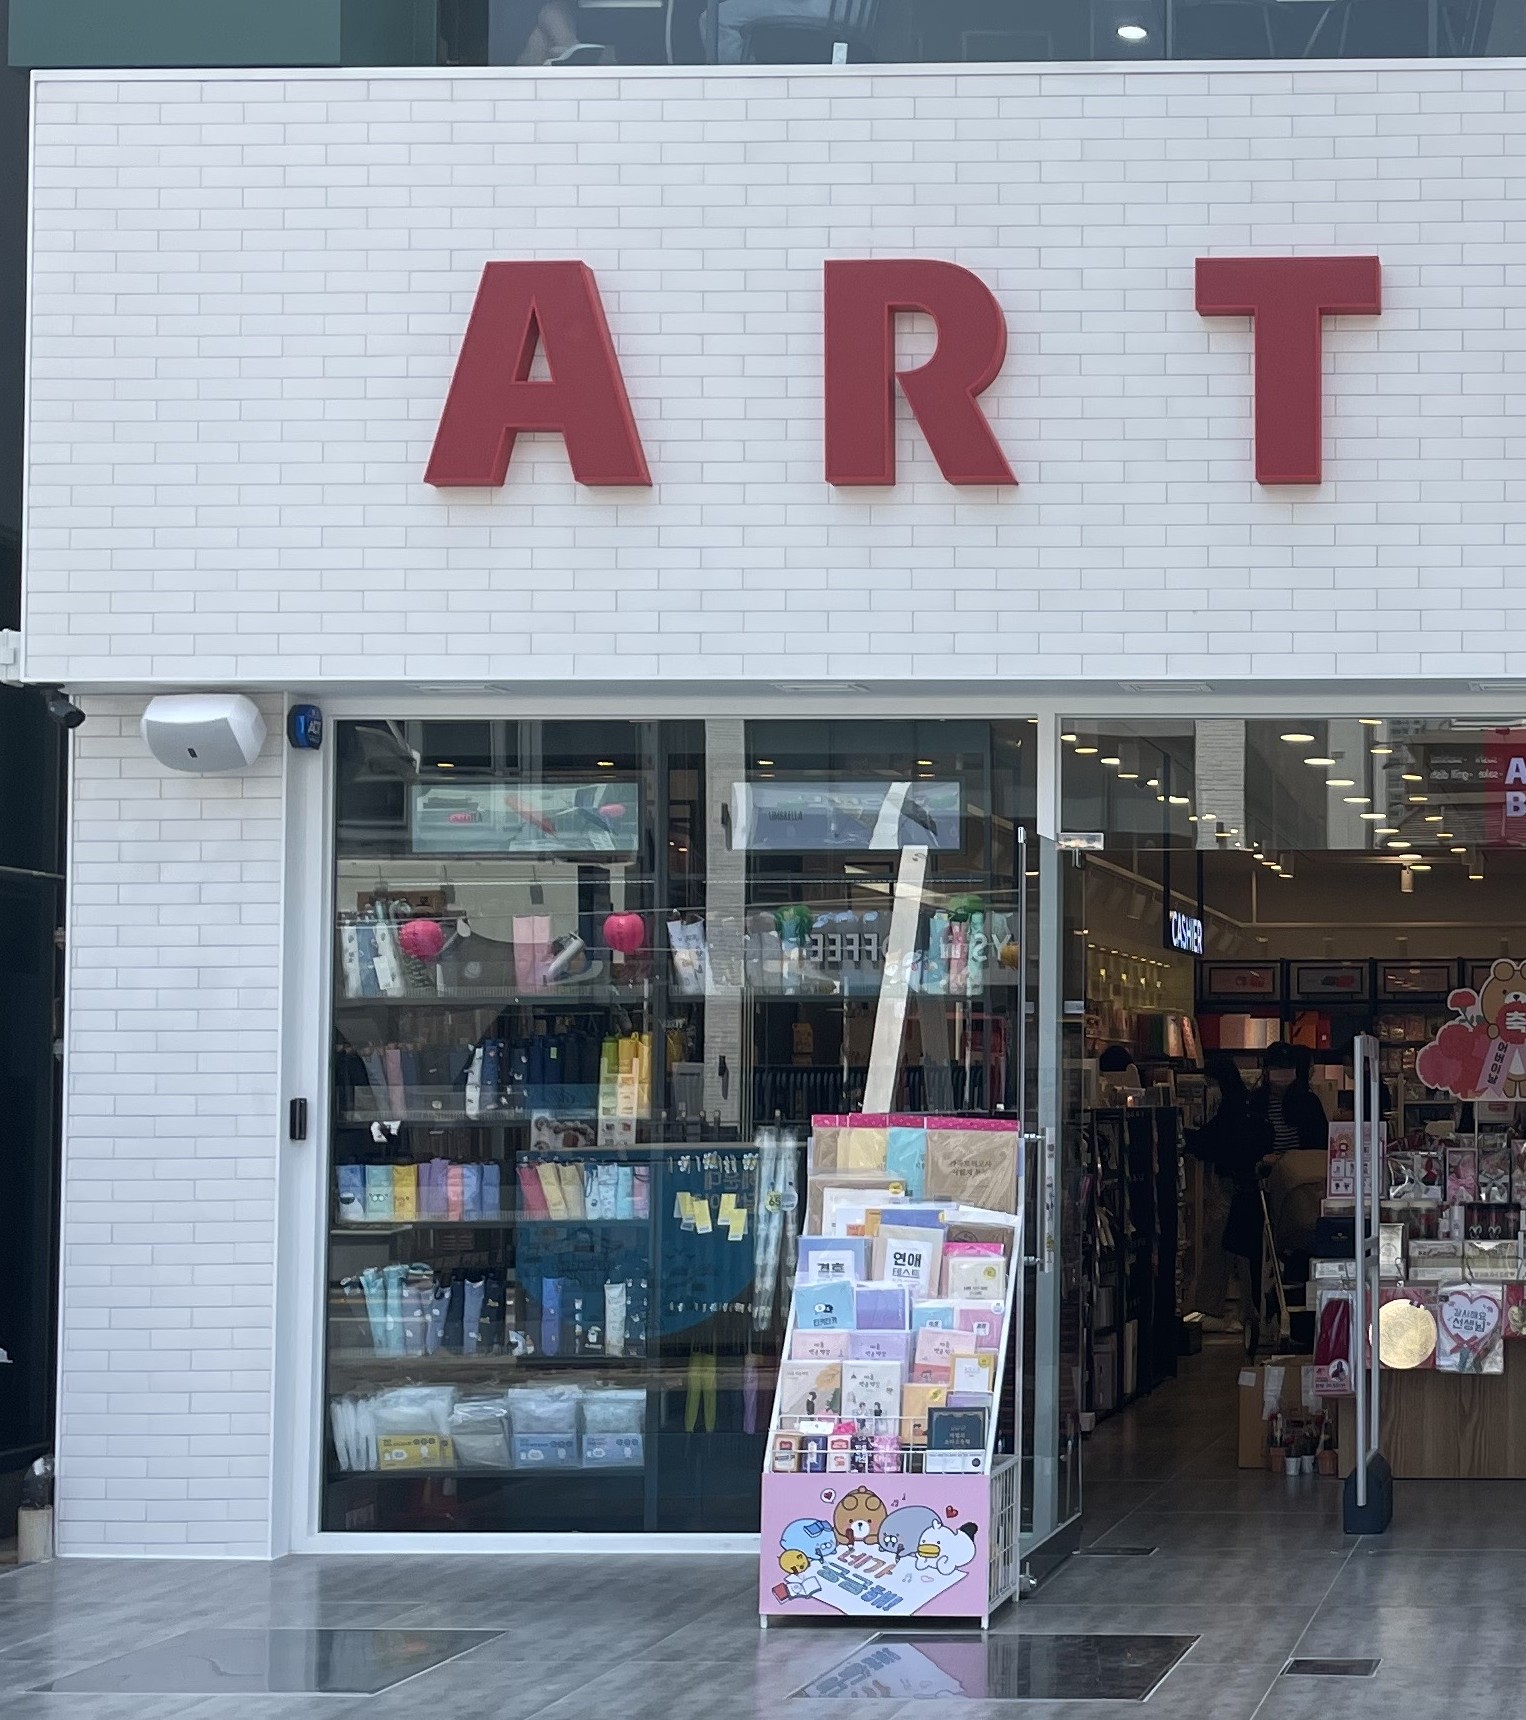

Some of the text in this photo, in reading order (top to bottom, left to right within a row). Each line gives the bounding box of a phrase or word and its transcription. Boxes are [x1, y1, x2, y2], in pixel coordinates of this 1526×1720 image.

[1168, 910, 1203, 955] CASHIER
[1505, 1010, 1526, 1034] 축
[1487, 1041, 1509, 1085] 어버이날
[893, 1251, 922, 1268] 연애
[891, 1267, 921, 1280] 테스트
[1452, 1318, 1486, 1333] 선생님
[837, 1548, 897, 1579] 네가
